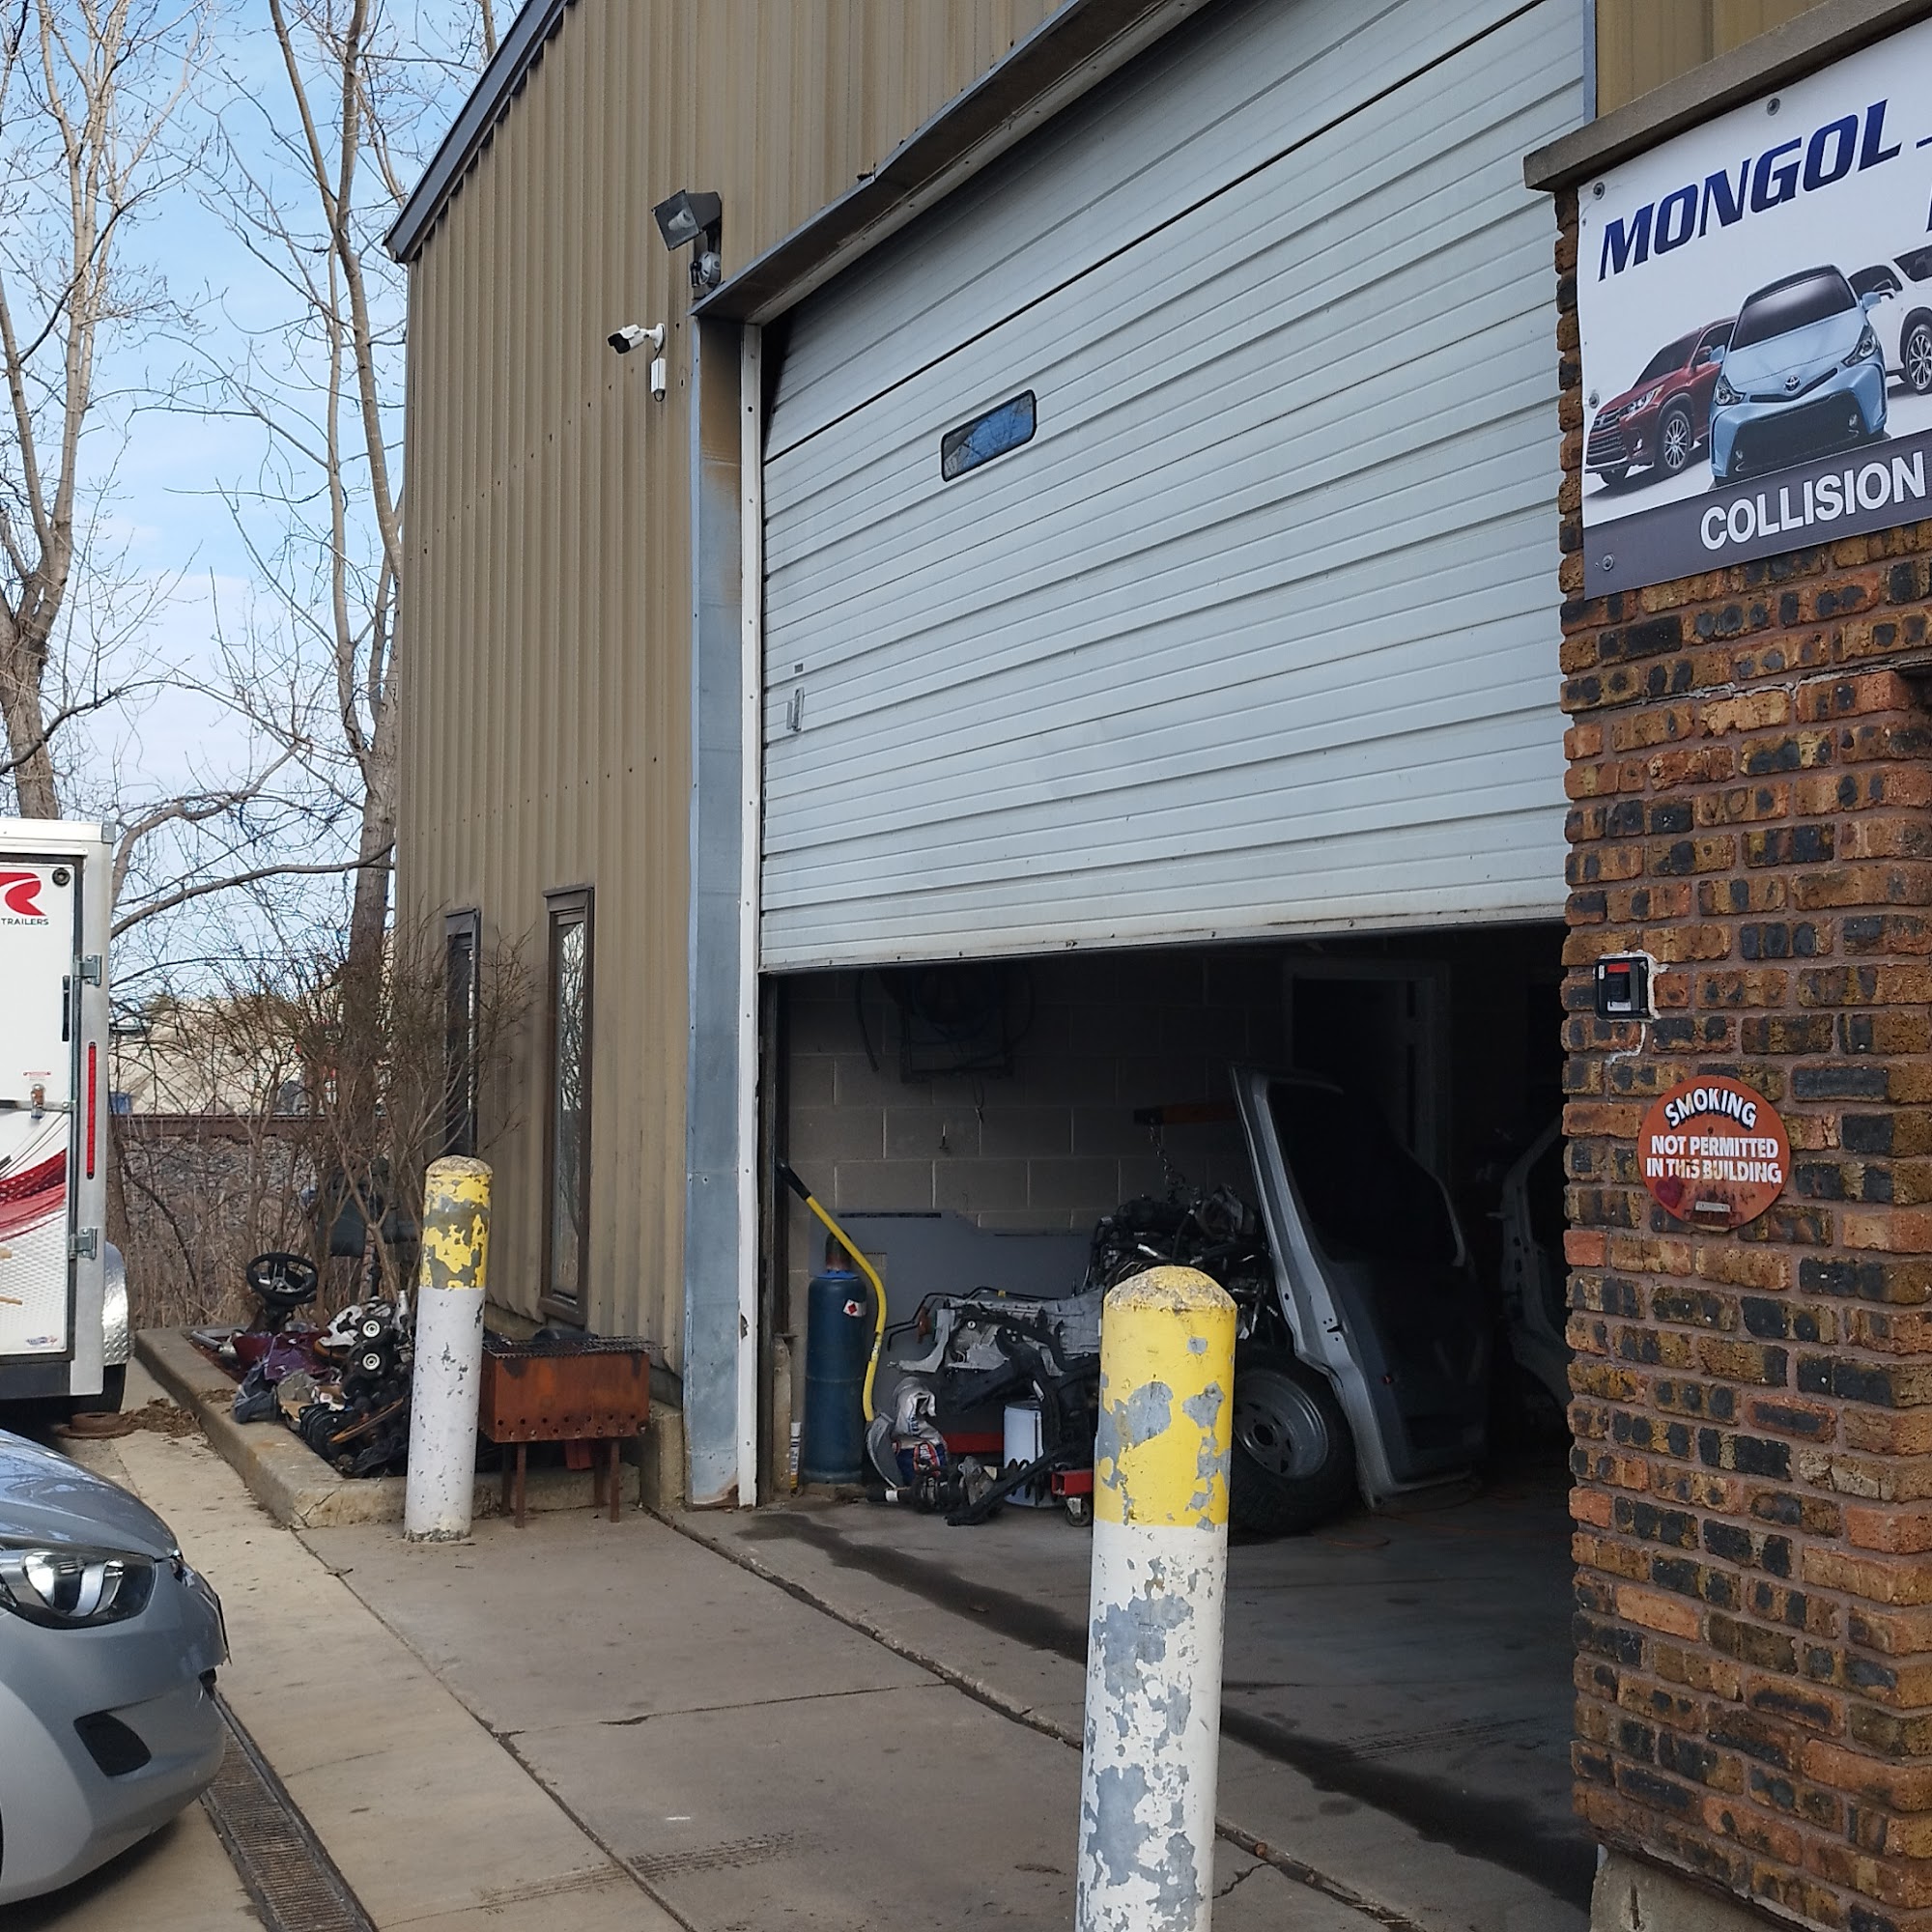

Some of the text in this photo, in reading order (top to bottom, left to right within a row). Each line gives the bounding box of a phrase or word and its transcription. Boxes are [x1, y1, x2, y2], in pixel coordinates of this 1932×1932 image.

[1598, 99, 1902, 281] MONGOL
[1700, 450, 1926, 551] COLLISION
[1664, 1087, 1757, 1129] SMOKING
[1651, 1135, 1779, 1158] NOT PERMITTED
[1646, 1157, 1664, 1178] IN
[1702, 1160, 1783, 1184] BUILDING
